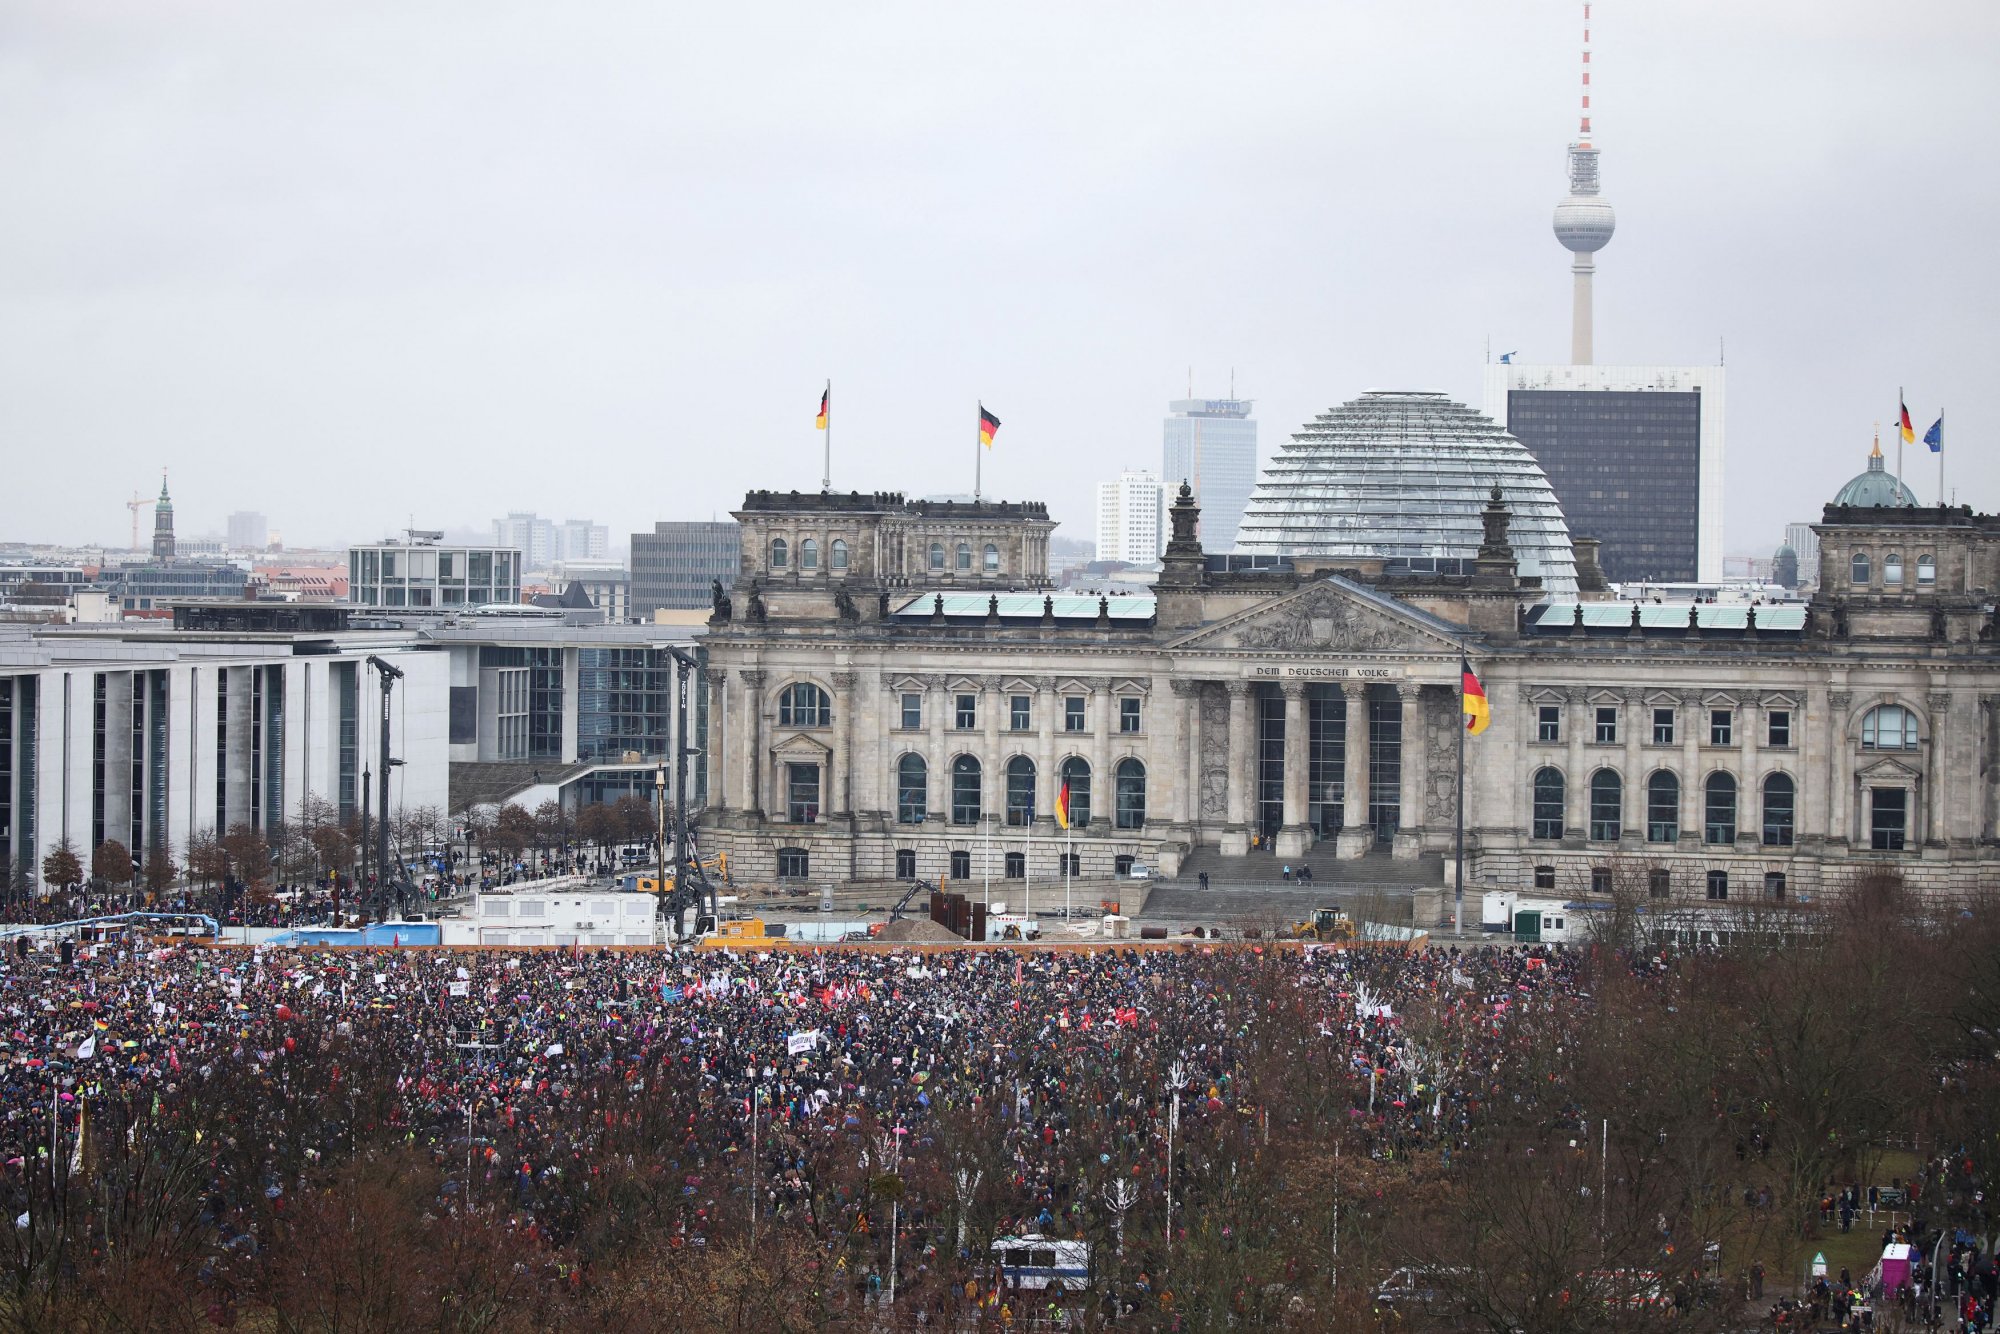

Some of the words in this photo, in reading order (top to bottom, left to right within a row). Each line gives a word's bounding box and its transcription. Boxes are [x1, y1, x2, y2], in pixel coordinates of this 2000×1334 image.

[1257, 667, 1280, 675] DEM
[1288, 667, 1349, 677] DEUTSCHEN
[1357, 669, 1389, 677] VOLKE
